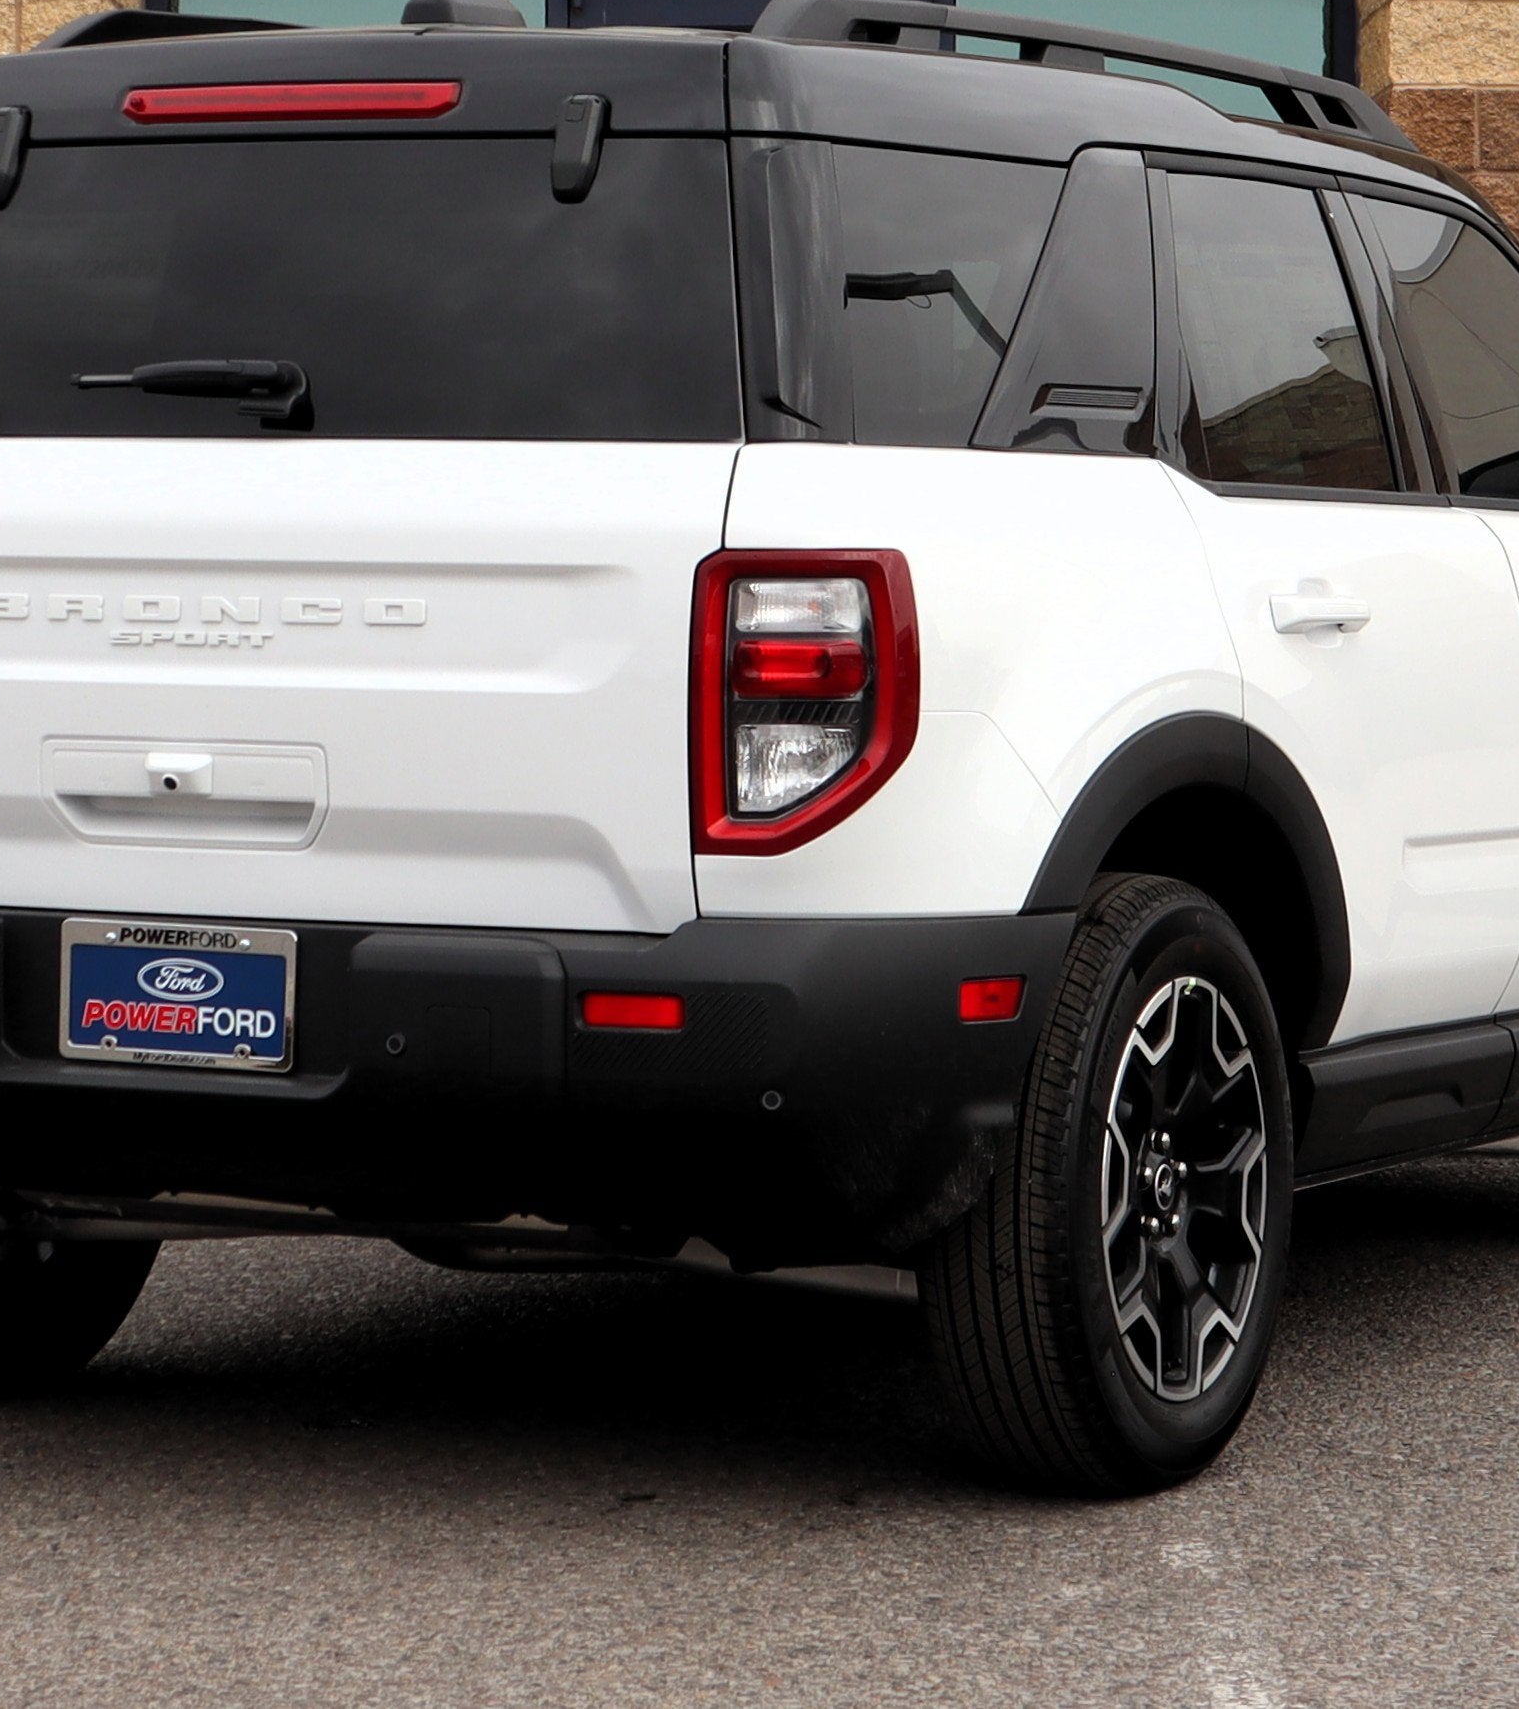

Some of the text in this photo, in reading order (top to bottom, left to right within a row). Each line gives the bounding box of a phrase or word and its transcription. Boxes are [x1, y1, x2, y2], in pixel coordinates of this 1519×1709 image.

[110, 630, 274, 647] SPORT
[120, 927, 237, 949] POWERFORD
[155, 965, 206, 992] Ford
[81, 999, 276, 1038] POWERFORD
